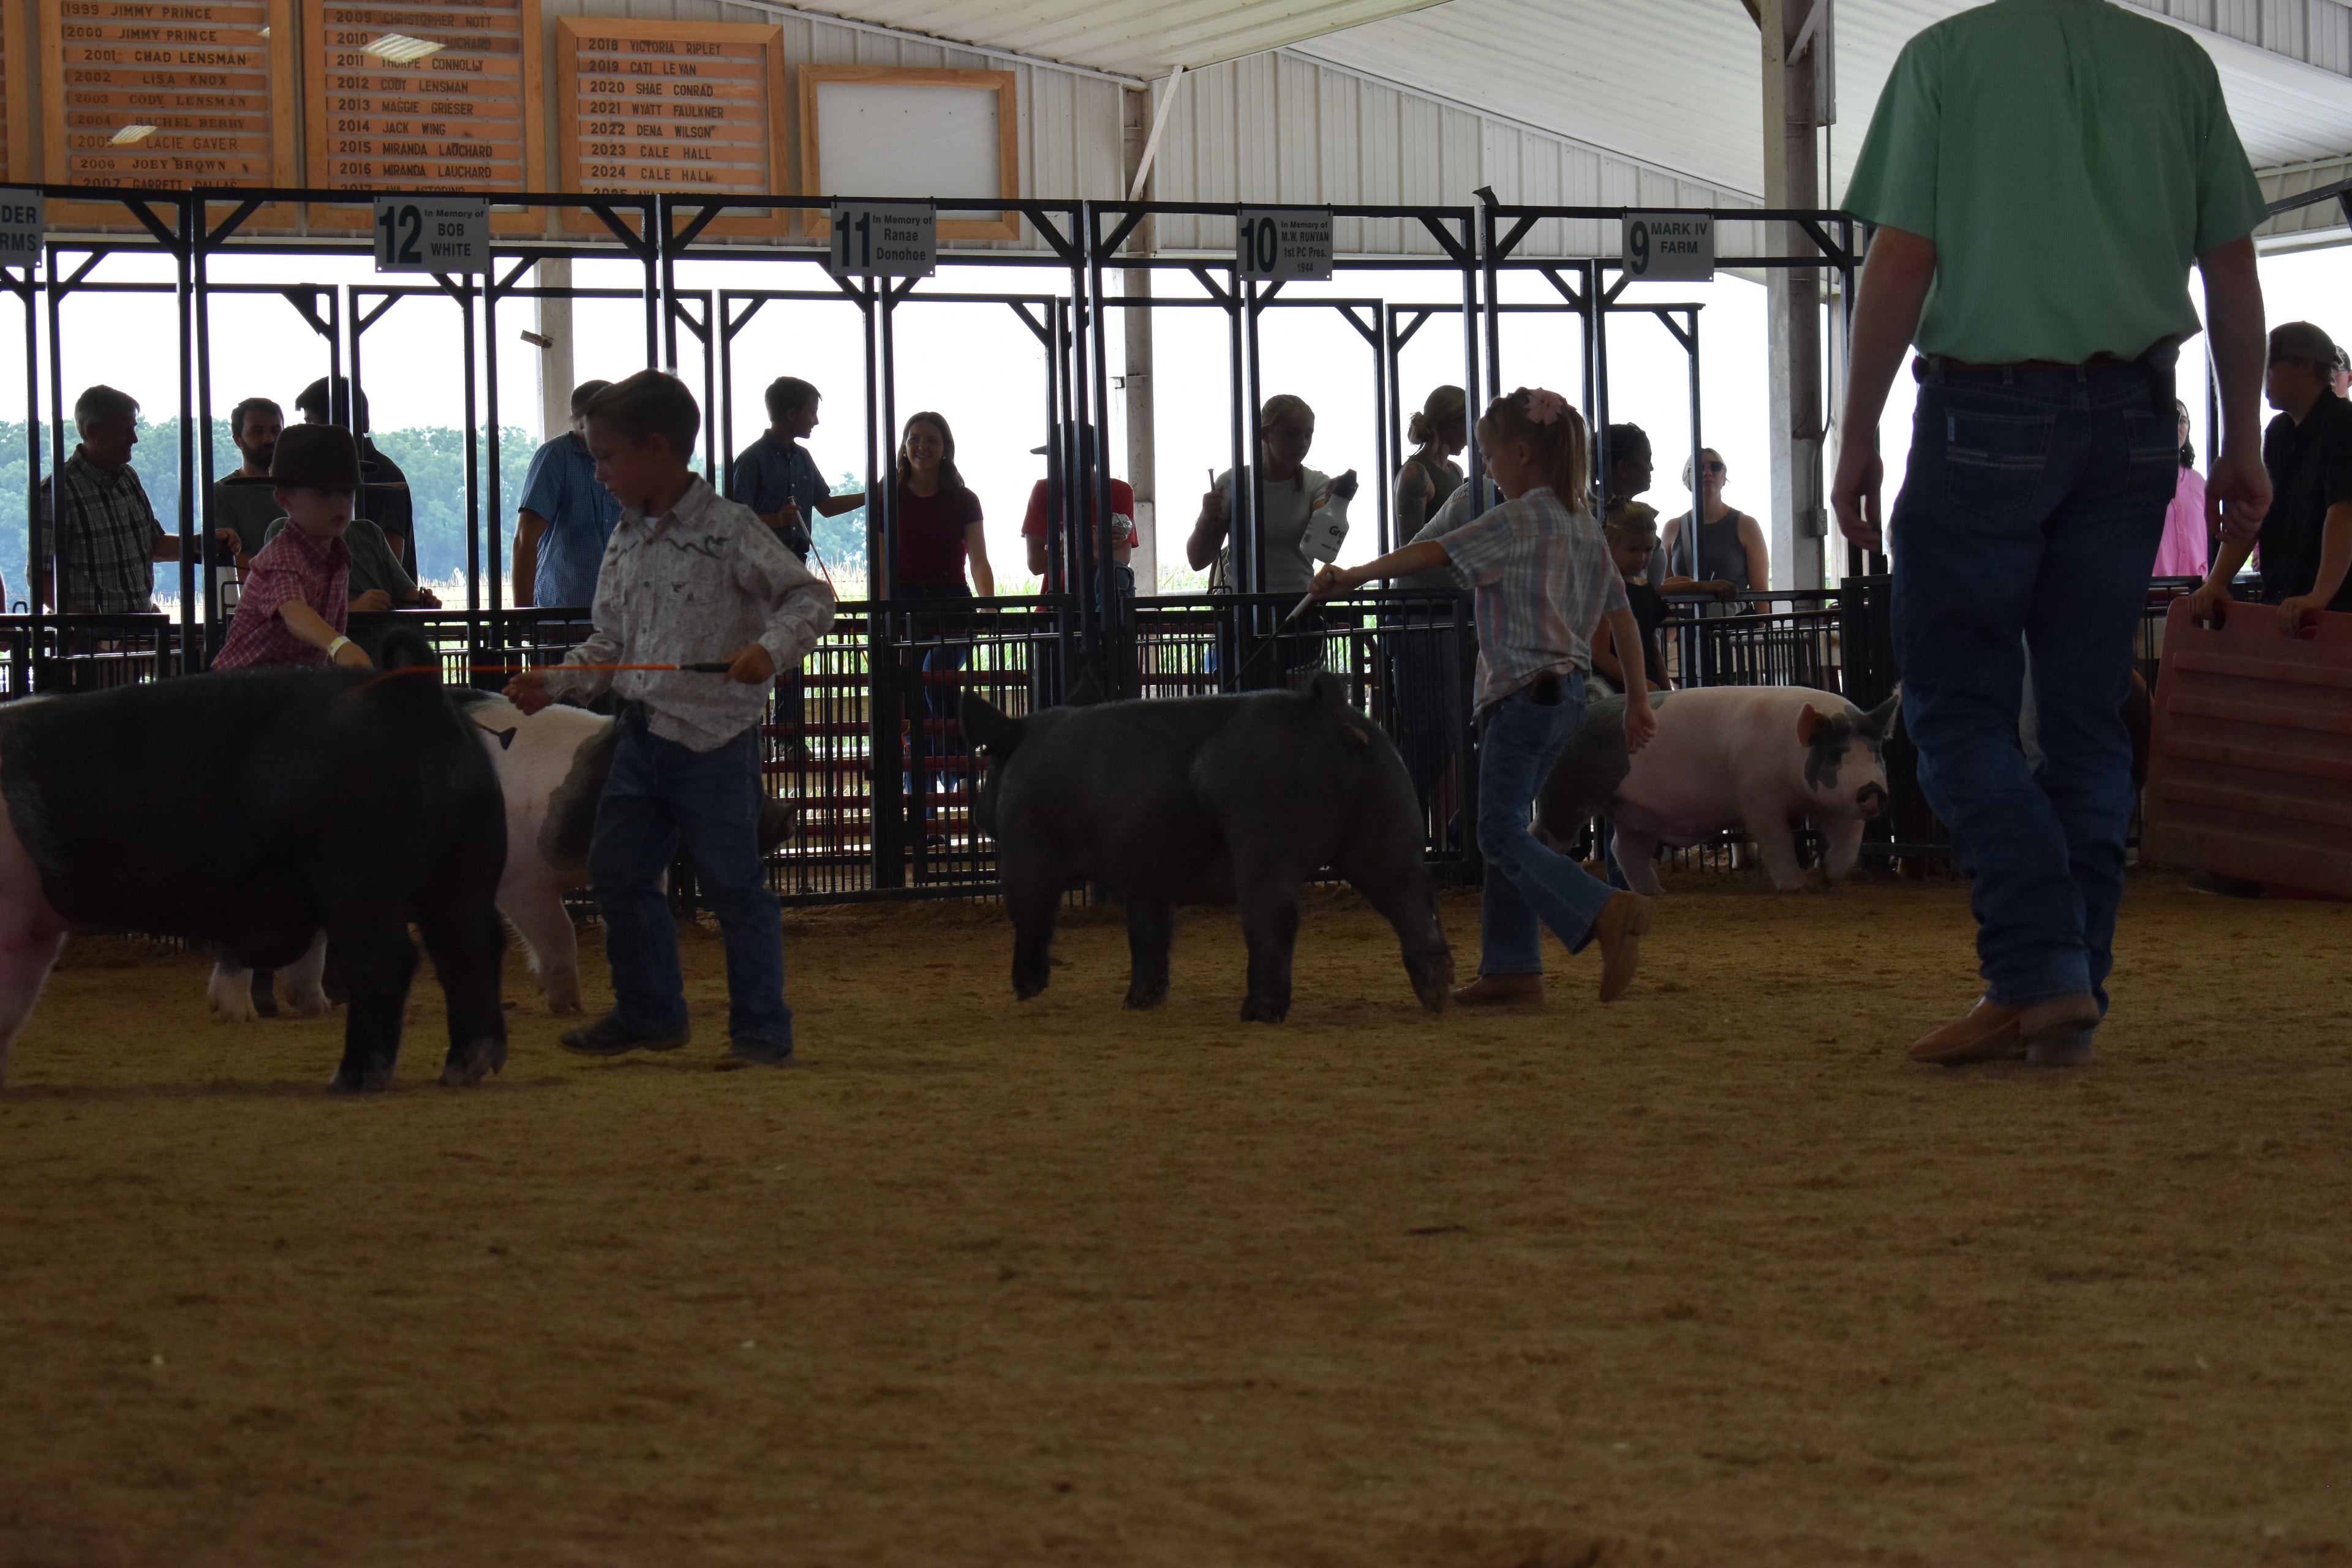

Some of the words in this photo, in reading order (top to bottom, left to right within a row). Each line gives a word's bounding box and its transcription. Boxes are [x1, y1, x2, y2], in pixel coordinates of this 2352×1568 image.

[66, 4, 99, 15] 1999
[111, 6, 153, 17] JIMMY
[162, 7, 211, 19] PRINCE
[336, 11, 372, 23] 2009
[384, 13, 454, 26] CHRISTOPHER
[466, 16, 491, 28] NOTT
[67, 27, 102, 38] 2000
[118, 29, 159, 40] JIMMY
[167, 30, 216, 41] PRINCE
[337, 32, 368, 44] 2010
[589, 38, 618, 51] 2018
[630, 40, 675, 53] VICTORIA
[686, 43, 721, 55] RIPLEY
[85, 50, 115, 61] 2001
[135, 51, 171, 62] CHAD
[180, 52, 246, 65] LENSMAN
[337, 55, 364, 66] 2011
[432, 58, 483, 72] CONNOLLY
[589, 60, 619, 72] 2019
[630, 62, 652, 74] CATI
[75, 72, 111, 82] 2002
[143, 74, 175, 85] LISA
[189, 75, 227, 86] KNOX
[337, 77, 369, 89] 2012
[381, 78, 405, 91] CODY
[419, 80, 468, 93] LENSMAN
[590, 81, 624, 93] 2020
[636, 83, 662, 94] SHAE
[674, 85, 713, 97] CONRAD
[75, 94, 108, 104] 2003
[129, 95, 164, 104] CODY
[176, 96, 246, 107] LENSMAN
[339, 99, 370, 110] 2013
[382, 100, 420, 113] MAGGIE
[431, 102, 473, 115] GRIESER
[590, 102, 620, 114] 2021
[632, 104, 662, 115] WYATT
[674, 105, 723, 118] FAULKNER
[78, 115, 111, 124] 2004
[135, 116, 192, 127] RACHEL
[199, 118, 244, 129] BERRY
[338, 119, 370, 132] 2014
[383, 122, 409, 133] JACK
[422, 123, 445, 135] WING
[591, 123, 625, 135] 2022
[637, 124, 663, 136] DENA
[674, 126, 711, 138] WILSON
[78, 135, 114, 148] 2005
[146, 137, 184, 149] LACIE
[194, 138, 238, 149] GAVER
[340, 141, 372, 153] 2015
[382, 142, 427, 155] MIRANDA
[592, 144, 625, 156] 2023
[640, 146, 669, 157] CALE
[684, 147, 711, 159] HALL
[81, 159, 115, 169] 2006
[132, 159, 168, 169] JOEY
[175, 160, 225, 171] BROWN
[340, 163, 371, 175] 2016
[383, 164, 426, 176] MIRANDA
[592, 165, 625, 178] 2024
[641, 168, 671, 179] CALE
[682, 170, 712, 181] HALL
[133, 179, 183, 190] GARRETT
[436, 209, 472, 219] Memory
[873, 215, 881, 224] In
[884, 216, 920, 226] Memory
[923, 216, 932, 225] of
[438, 223, 464, 236] BOB
[1290, 221, 1318, 230] Memory
[1651, 223, 1691, 235] MARK
[1695, 223, 1708, 235] IV
[379, 205, 423, 263] 12
[835, 212, 870, 267] 11
[884, 228, 918, 242] Ranae
[1281, 232, 1297, 242] M.W.
[1300, 232, 1329, 242] RUNYAN
[431, 243, 471, 257] WHITE
[1241, 217, 1277, 273] 10
[1284, 247, 1294, 257] 1st
[1297, 247, 1306, 257] PC
[1309, 247, 1327, 257] Pres.
[1630, 221, 1649, 275] 9
[1660, 241, 1698, 253] FARM
[876, 247, 926, 261] Donohoe
[1297, 263, 1313, 273] 1944
